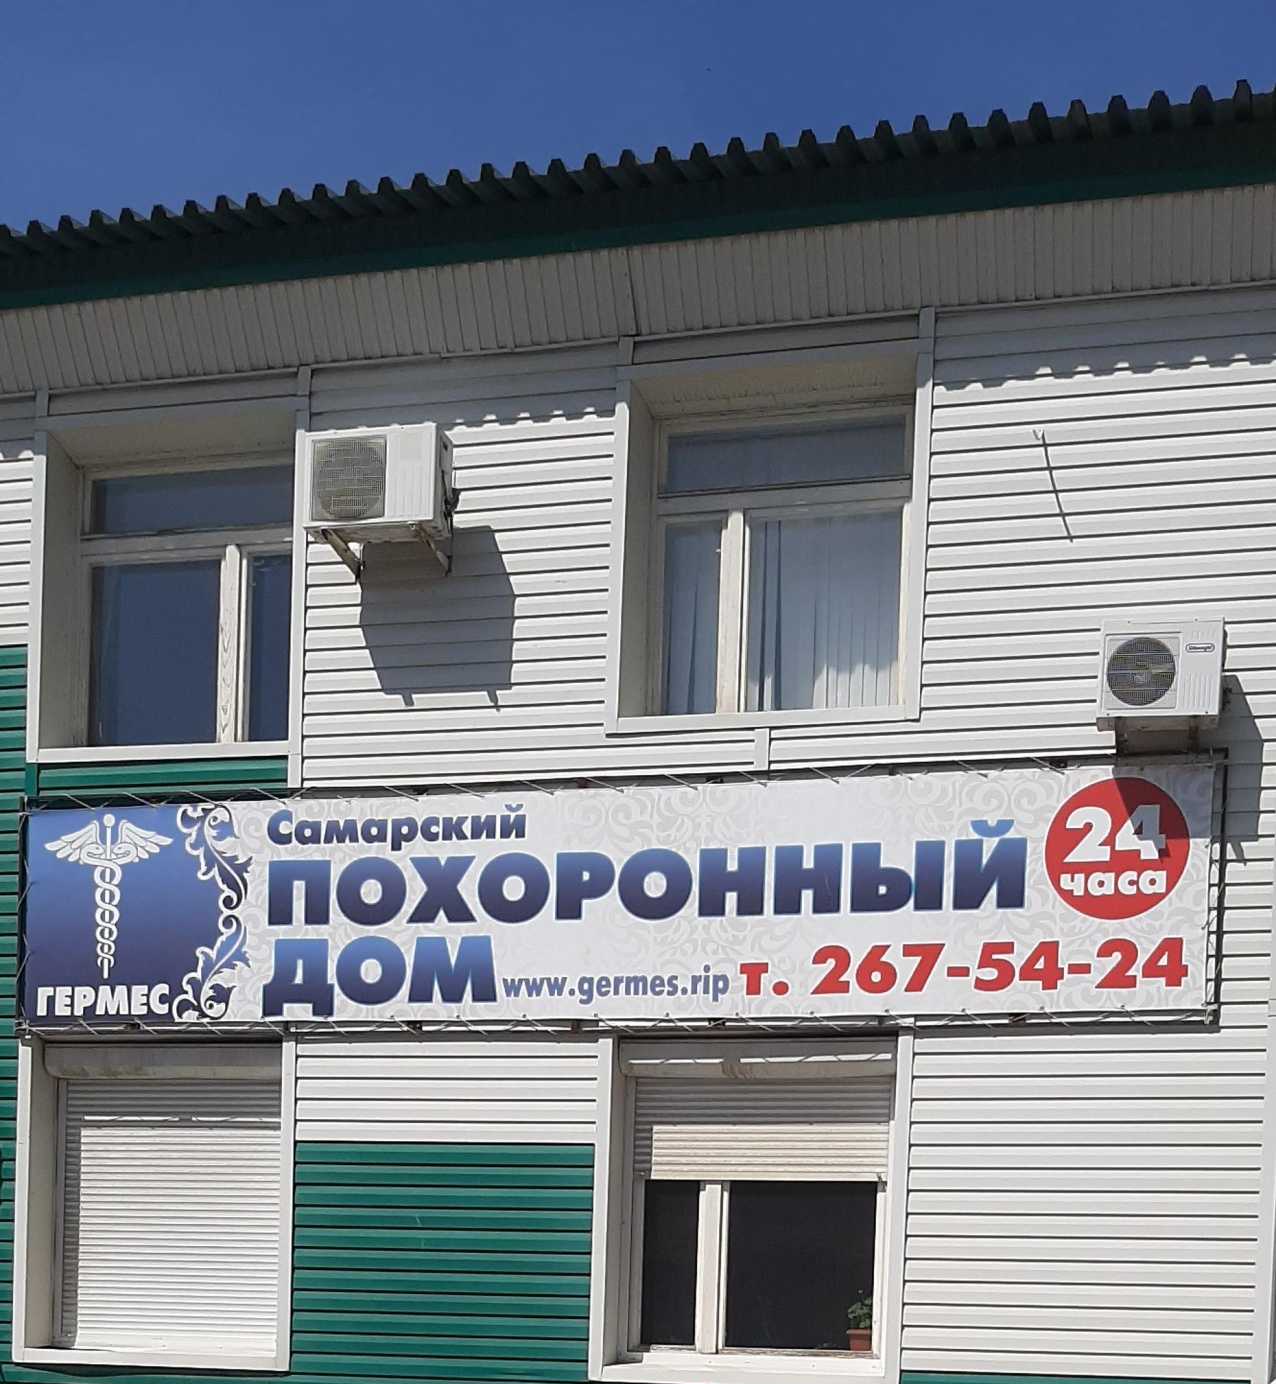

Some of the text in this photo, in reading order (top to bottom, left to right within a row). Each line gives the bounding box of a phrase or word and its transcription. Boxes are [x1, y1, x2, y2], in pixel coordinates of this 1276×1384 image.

[266, 803, 527, 851] Самарский
[1062, 804, 1166, 864] 24
[266, 818, 1028, 926] ПОХОРОННЫЙ
[1058, 868, 1168, 898] часа
[262, 935, 498, 1018] ДОМ
[502, 964, 730, 1005] www.germes.rip
[810, 937, 1190, 996] 267-54-24
[36, 983, 170, 1016] ГЕРМЕС
